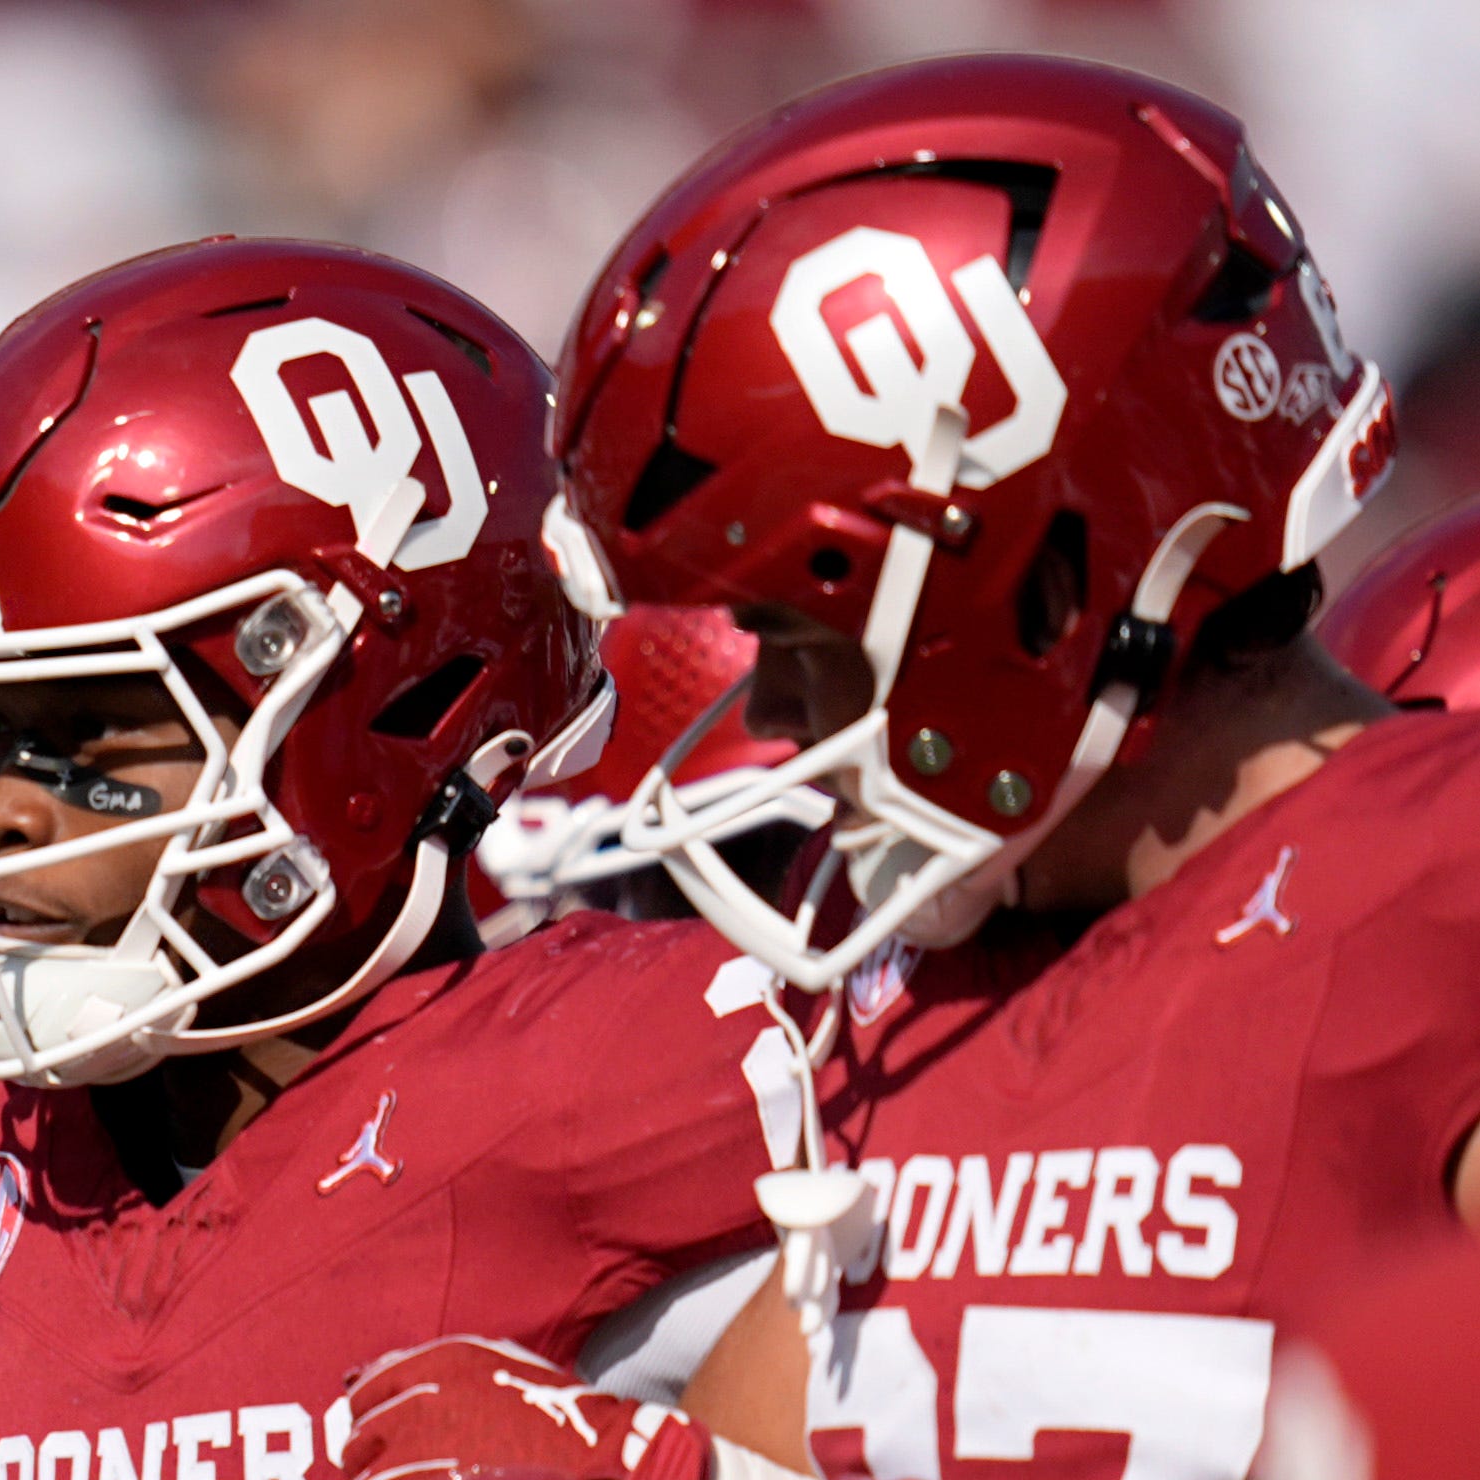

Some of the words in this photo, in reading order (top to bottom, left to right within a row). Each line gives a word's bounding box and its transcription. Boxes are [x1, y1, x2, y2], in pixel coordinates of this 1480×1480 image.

[230, 317, 489, 571] OU
[770, 226, 1067, 490] OU
[839, 1144, 1243, 1282] ONERS
